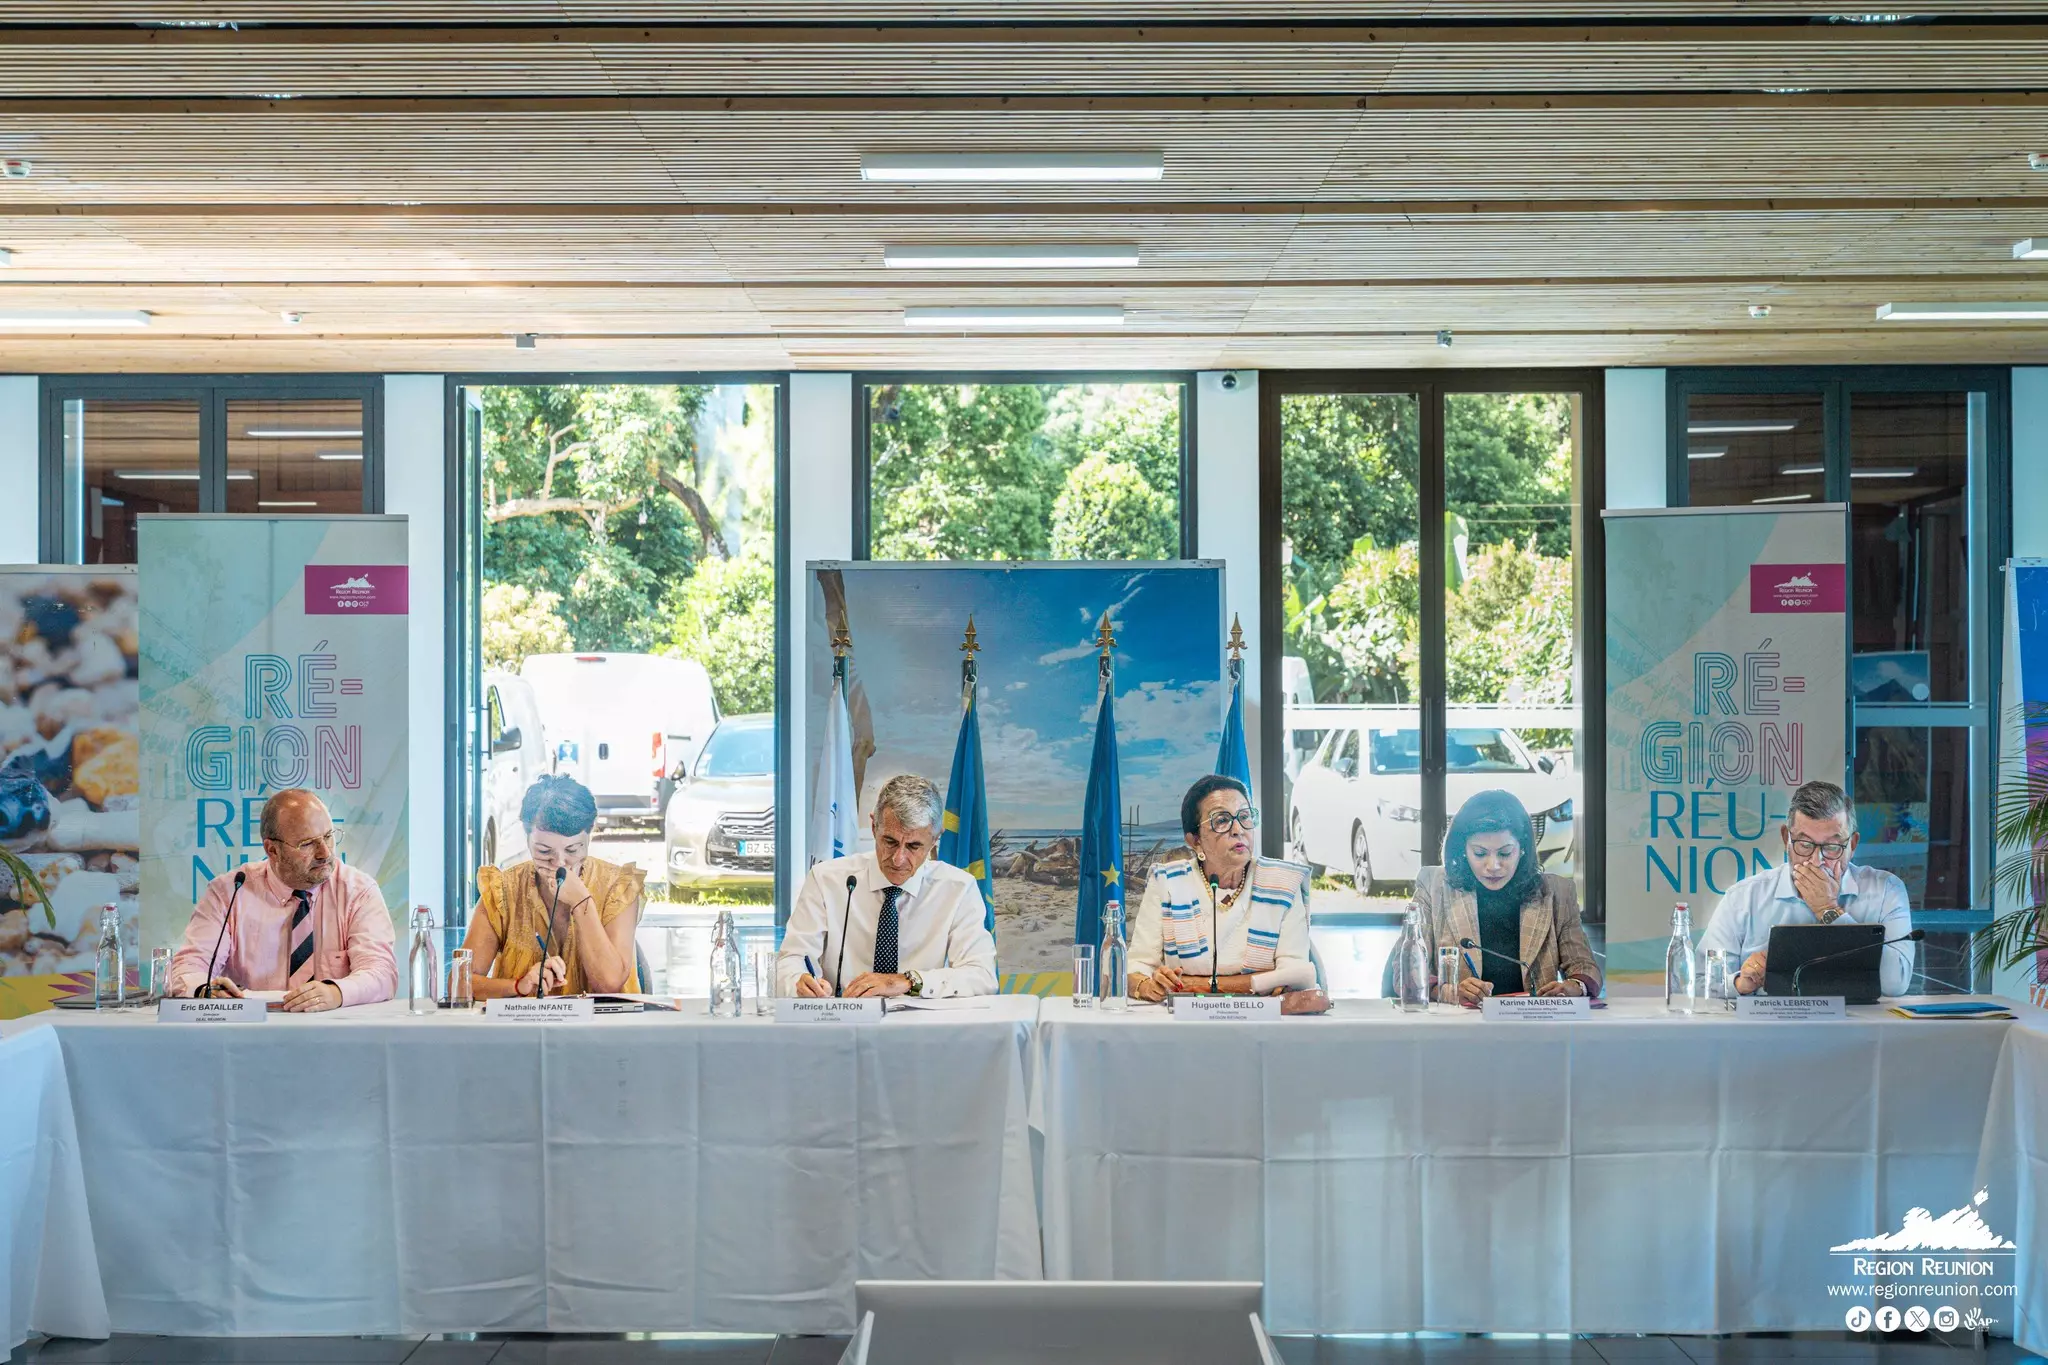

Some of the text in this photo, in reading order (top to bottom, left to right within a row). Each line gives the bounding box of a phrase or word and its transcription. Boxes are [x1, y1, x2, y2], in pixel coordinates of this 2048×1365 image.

[185, 725, 361, 791] GION
[1640, 721, 1804, 787] GION
[181, 1003, 244, 1011] Eric BATAILLER
[504, 1003, 573, 1011] Nathalie INFANTE
[793, 1003, 863, 1011] Patrice LATRON
[1191, 1001, 1265, 1011] Huguette BELLO
[1753, 999, 1829, 1007] Patrick LEBRETON
